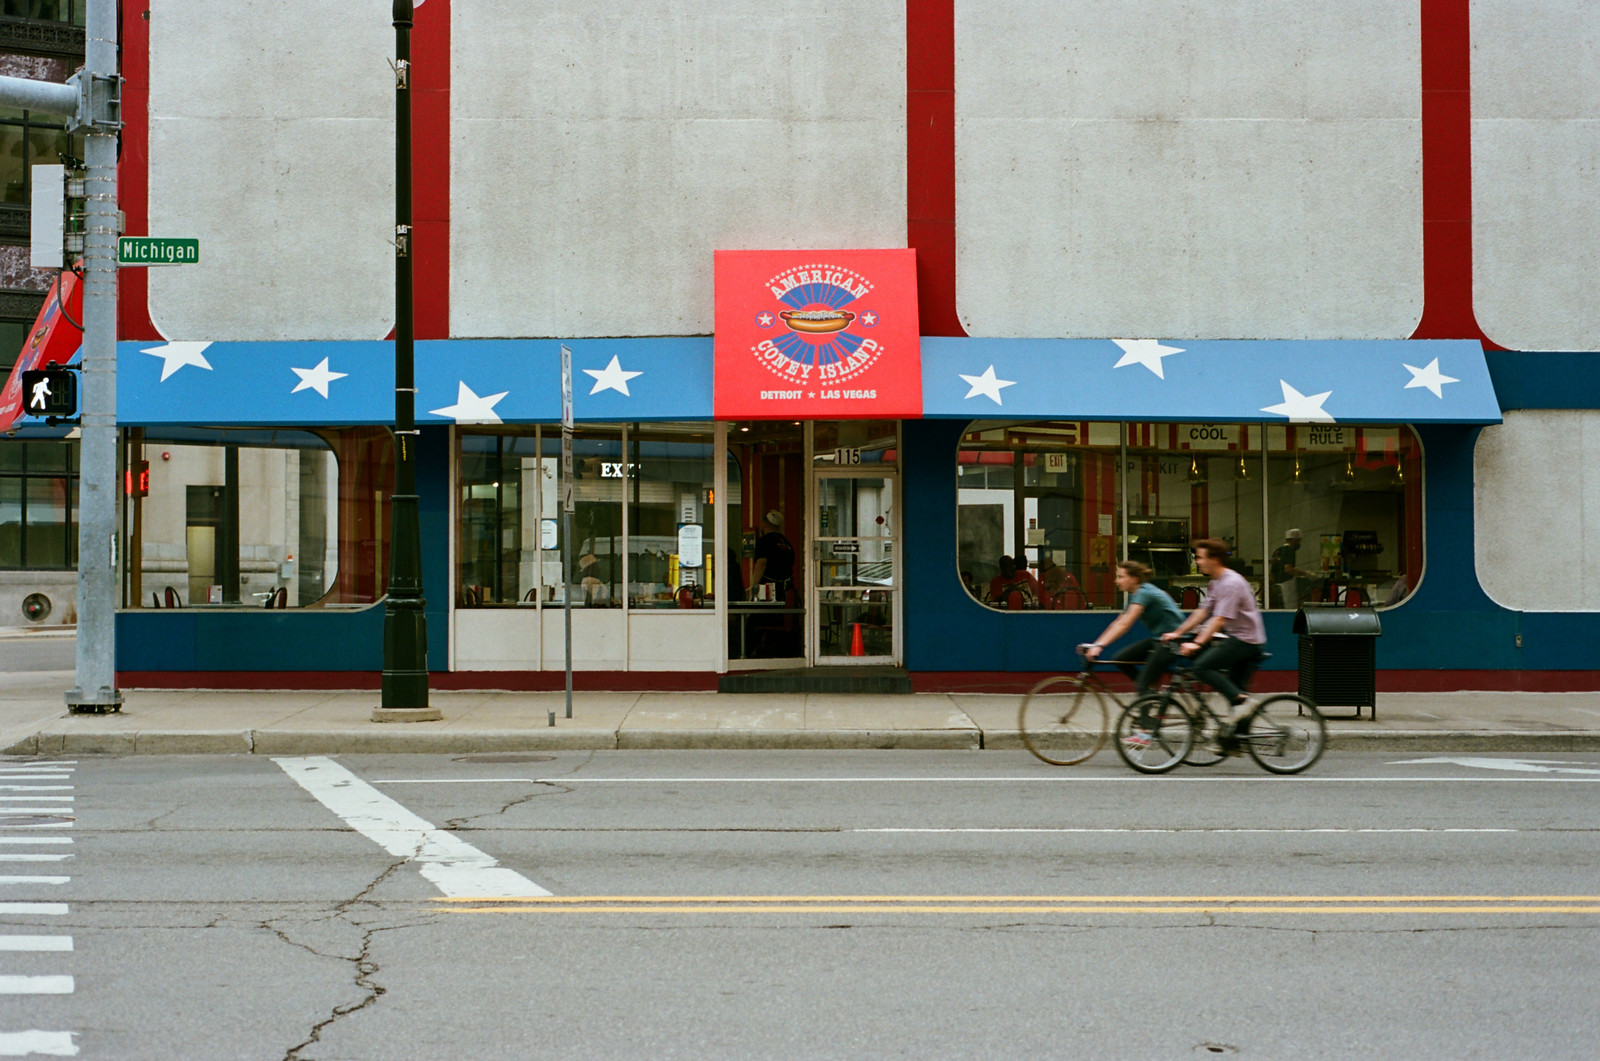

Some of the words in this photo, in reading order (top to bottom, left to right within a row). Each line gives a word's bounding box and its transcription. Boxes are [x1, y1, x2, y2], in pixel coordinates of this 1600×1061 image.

[123, 241, 195, 262] Michigan
[770, 269, 869, 300] AMERICAN
[757, 339, 813, 379] CONEY
[818, 338, 878, 379] ISLAND
[760, 390, 802, 400] DETROIT
[820, 390, 841, 399] LAS
[843, 390, 877, 399] VEGAS
[1190, 428, 1228, 440] COOL
[1309, 432, 1344, 445] RULE
[837, 449, 860, 465] 115
[1049, 454, 1065, 467] EXIT
